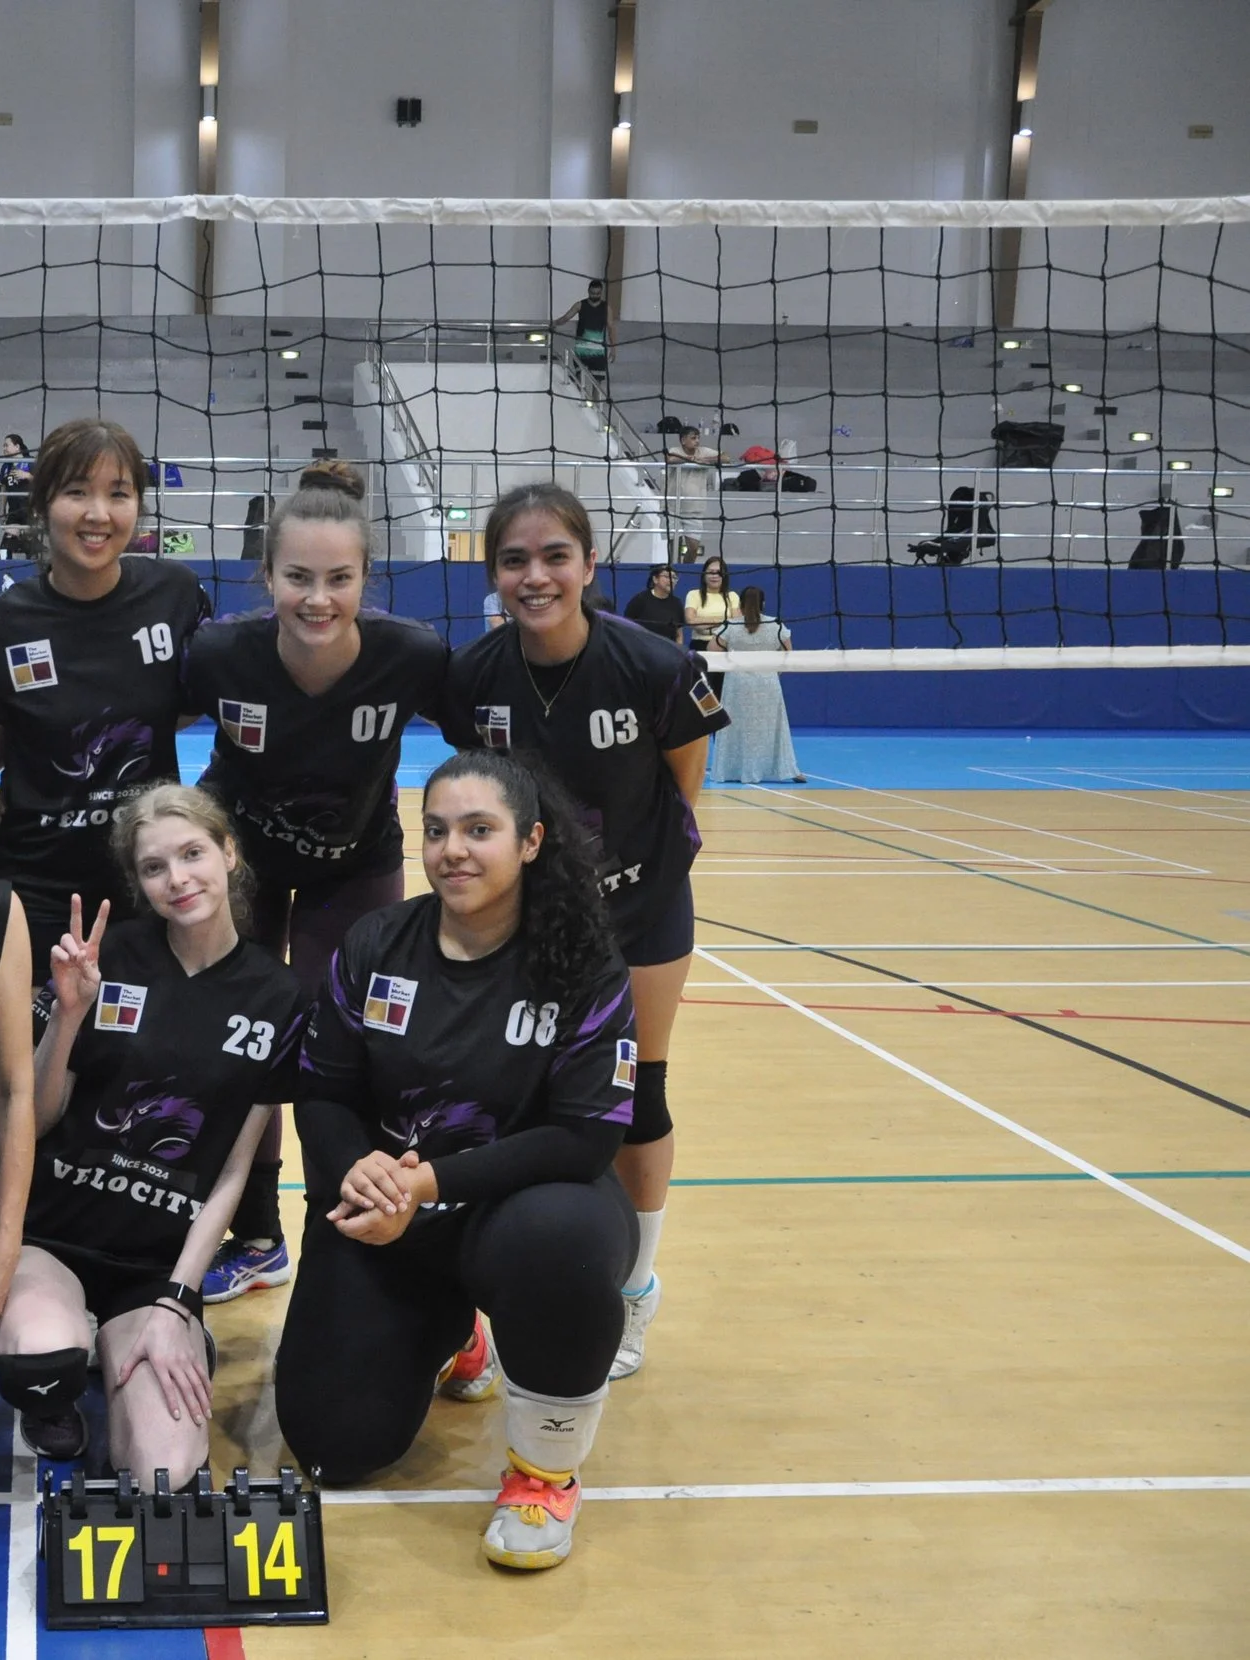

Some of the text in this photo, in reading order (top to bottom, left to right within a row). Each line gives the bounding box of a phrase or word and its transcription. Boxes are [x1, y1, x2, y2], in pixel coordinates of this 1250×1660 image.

[132, 622, 174, 664] 19
[351, 701, 397, 742] 07
[589, 708, 639, 749] 03
[221, 1014, 275, 1061] 23
[505, 999, 560, 1047] 08
[111, 1153, 170, 1180] SINCE 2024
[68, 1525, 136, 1600] 17
[233, 1521, 303, 1596] 14
